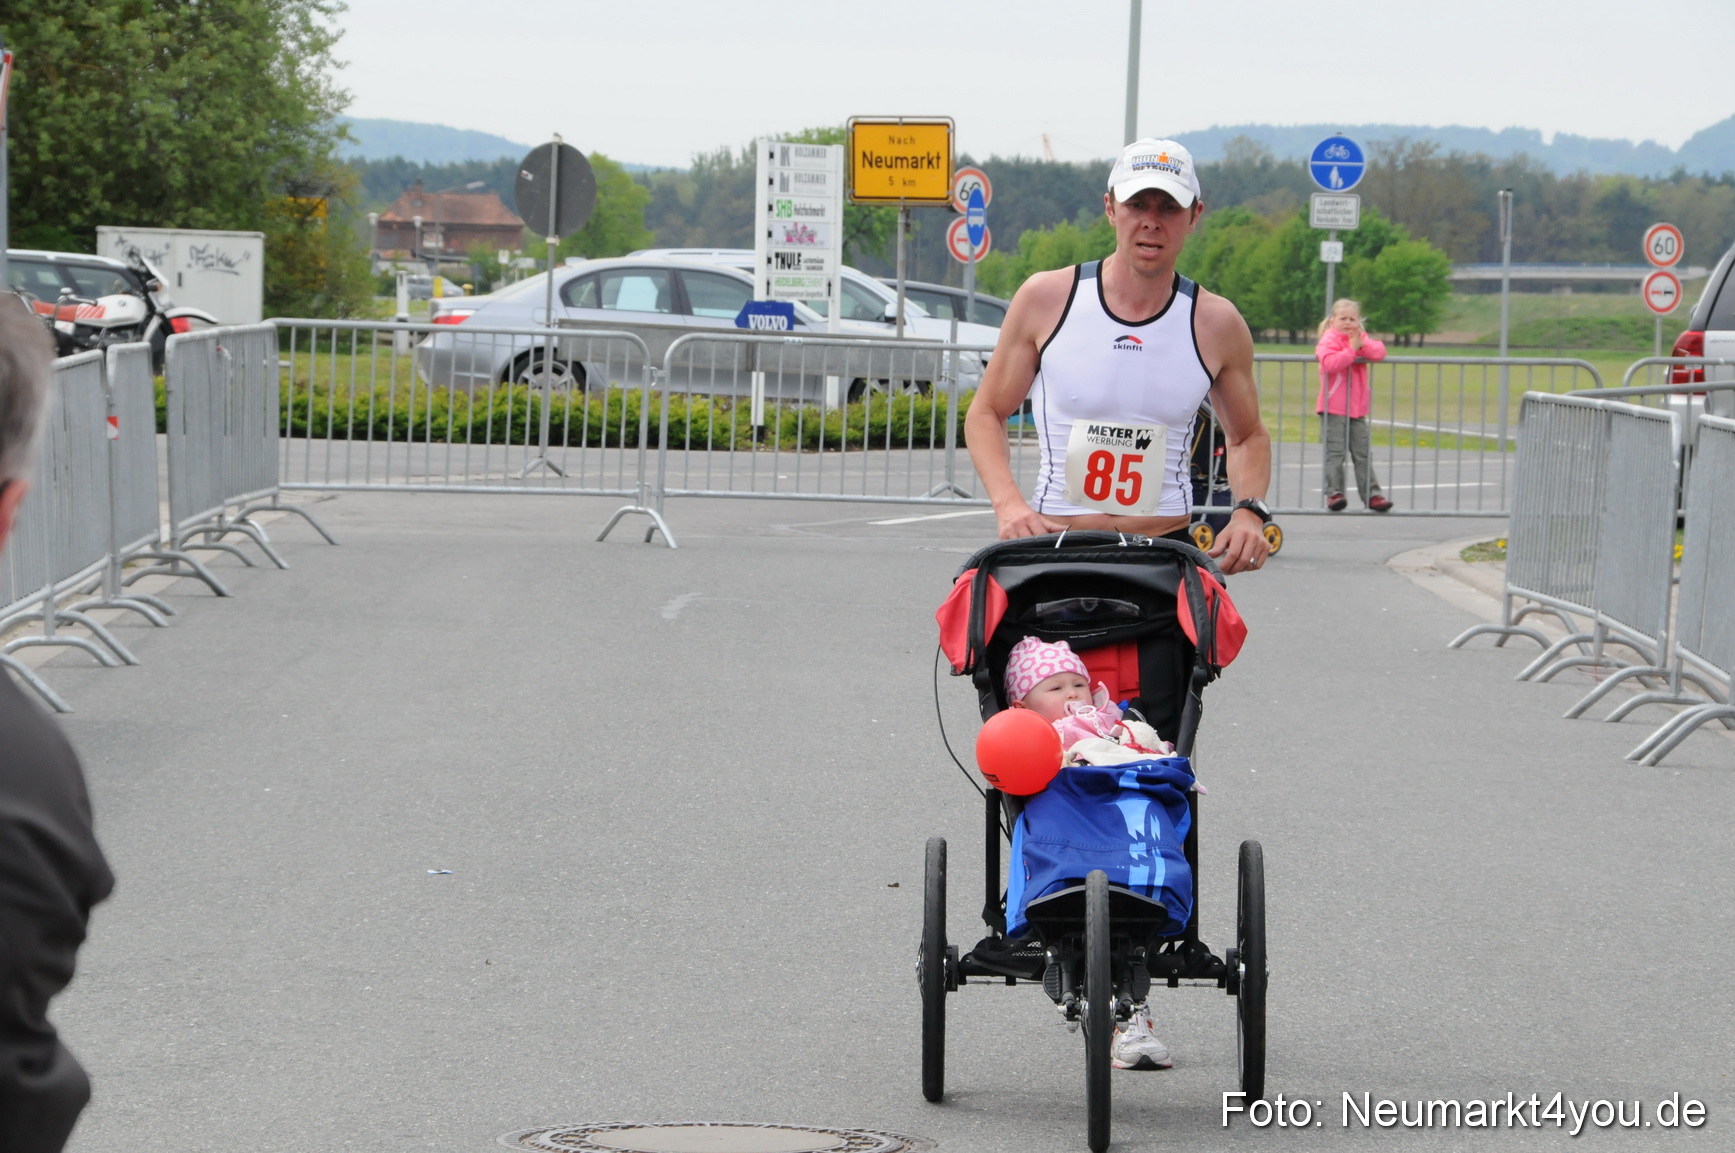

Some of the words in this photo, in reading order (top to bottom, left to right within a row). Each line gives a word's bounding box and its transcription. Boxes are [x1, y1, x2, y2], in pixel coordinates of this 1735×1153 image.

[888, 135, 916, 145] Nach
[861, 150, 941, 169] Neumarkt
[1132, 152, 1184, 168] IRONMAN
[888, 176, 894, 186] 5
[902, 177, 916, 187] km
[776, 199, 793, 218] SHB
[1654, 236, 1675, 255] 60
[774, 252, 802, 270] THULE
[747, 314, 788, 331] VOLVO
[1113, 344, 1143, 352] skinfit
[1087, 424, 1133, 439] MEYER
[1086, 435, 1133, 448] WERBUNG
[1083, 450, 1144, 507] 85
